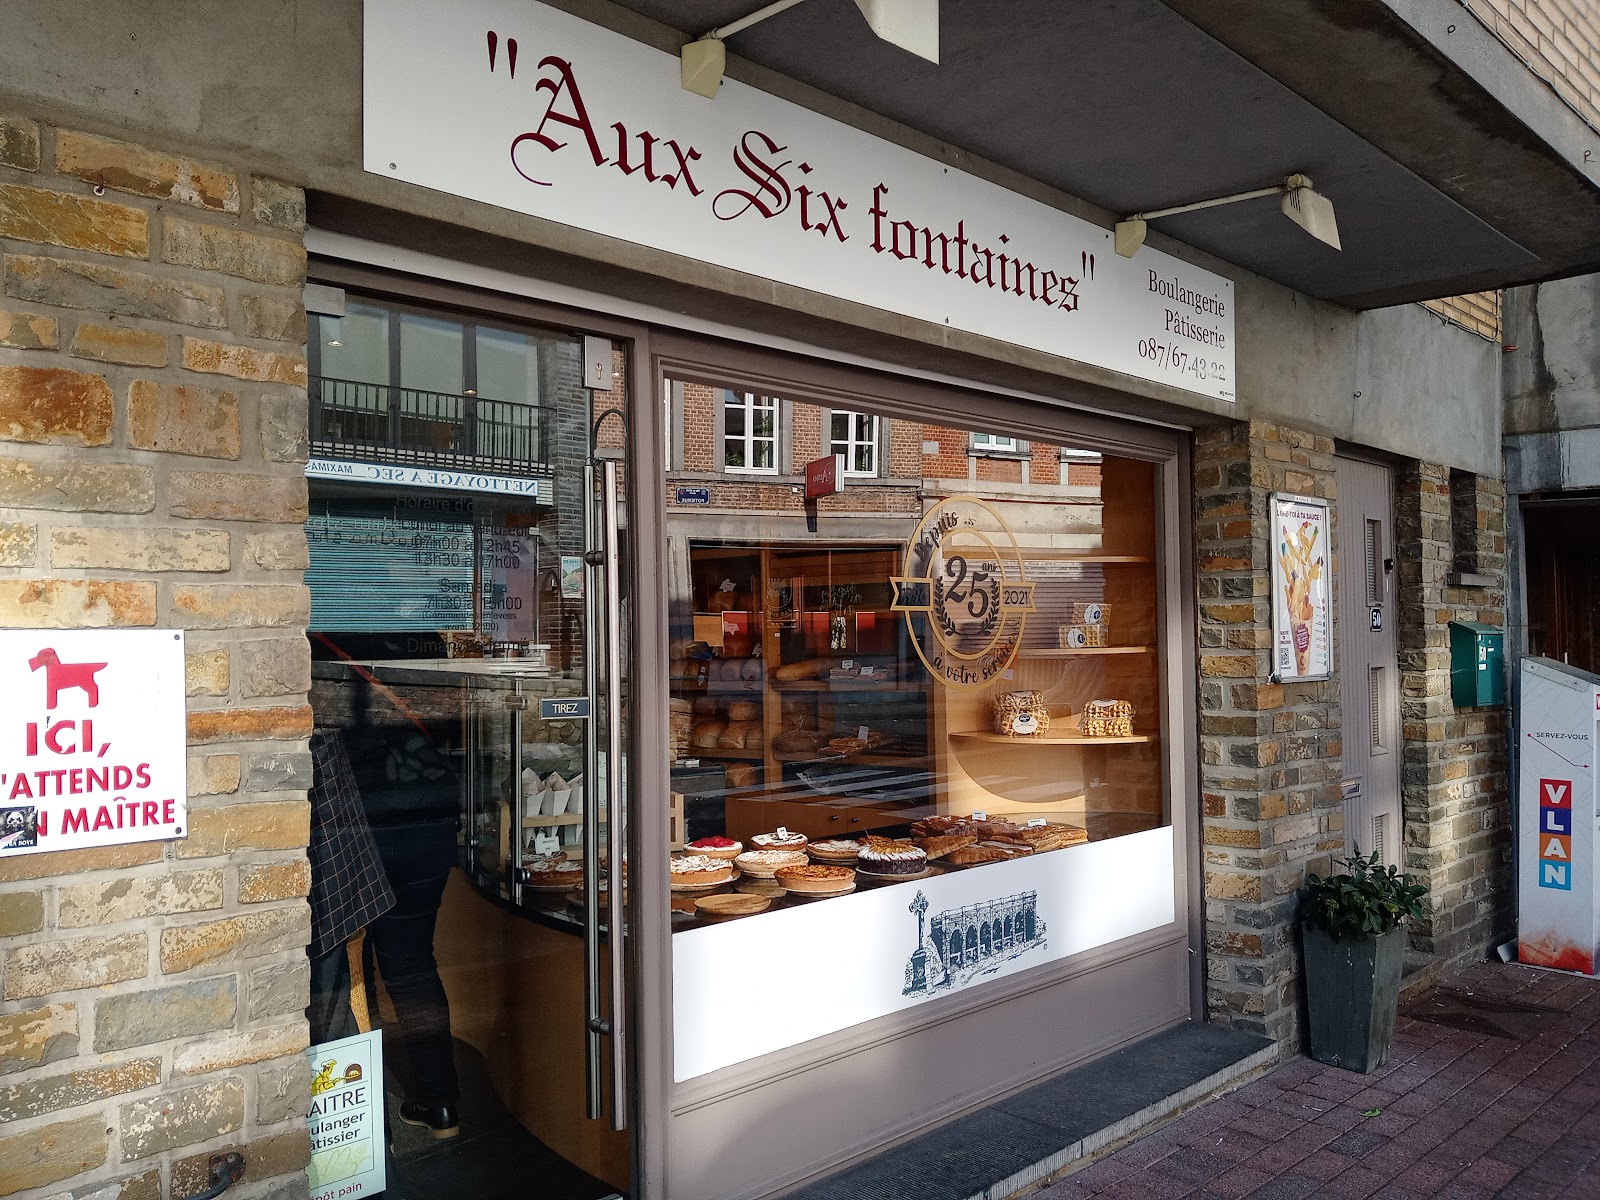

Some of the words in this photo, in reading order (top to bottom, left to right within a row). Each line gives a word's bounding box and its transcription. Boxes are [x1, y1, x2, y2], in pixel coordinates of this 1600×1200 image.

[487, 30, 704, 197] "Aux
[713, 130, 850, 243] Six
[869, 182, 1095, 312] fontaines"
[1148, 269, 1225, 318] Boulangerie
[1164, 309, 1225, 349] Pâtisserie
[1138, 338, 1226, 381] 087/67.43.22
[396, 497, 450, 511] Horaire
[483, 539, 520, 553] 2h45
[415, 553, 459, 567] 13h30
[483, 555, 520, 569] 7h00
[438, 578, 496, 593] Samedi
[945, 555, 989, 618] 25
[1004, 590, 1028, 605] 2021
[1373, 611, 1382, 626] 50
[946, 664, 979, 685] votre
[552, 703, 579, 714] TIREZ
[1536, 732, 1589, 741] SERVEZ-VOUS
[61, 795, 175, 835] MAÎTRE
[1543, 783, 1568, 886] VLAN
[306, 1086, 366, 1119] AITRE
[309, 1111, 366, 1136] ulanger
[338, 1182, 362, 1198] pain
